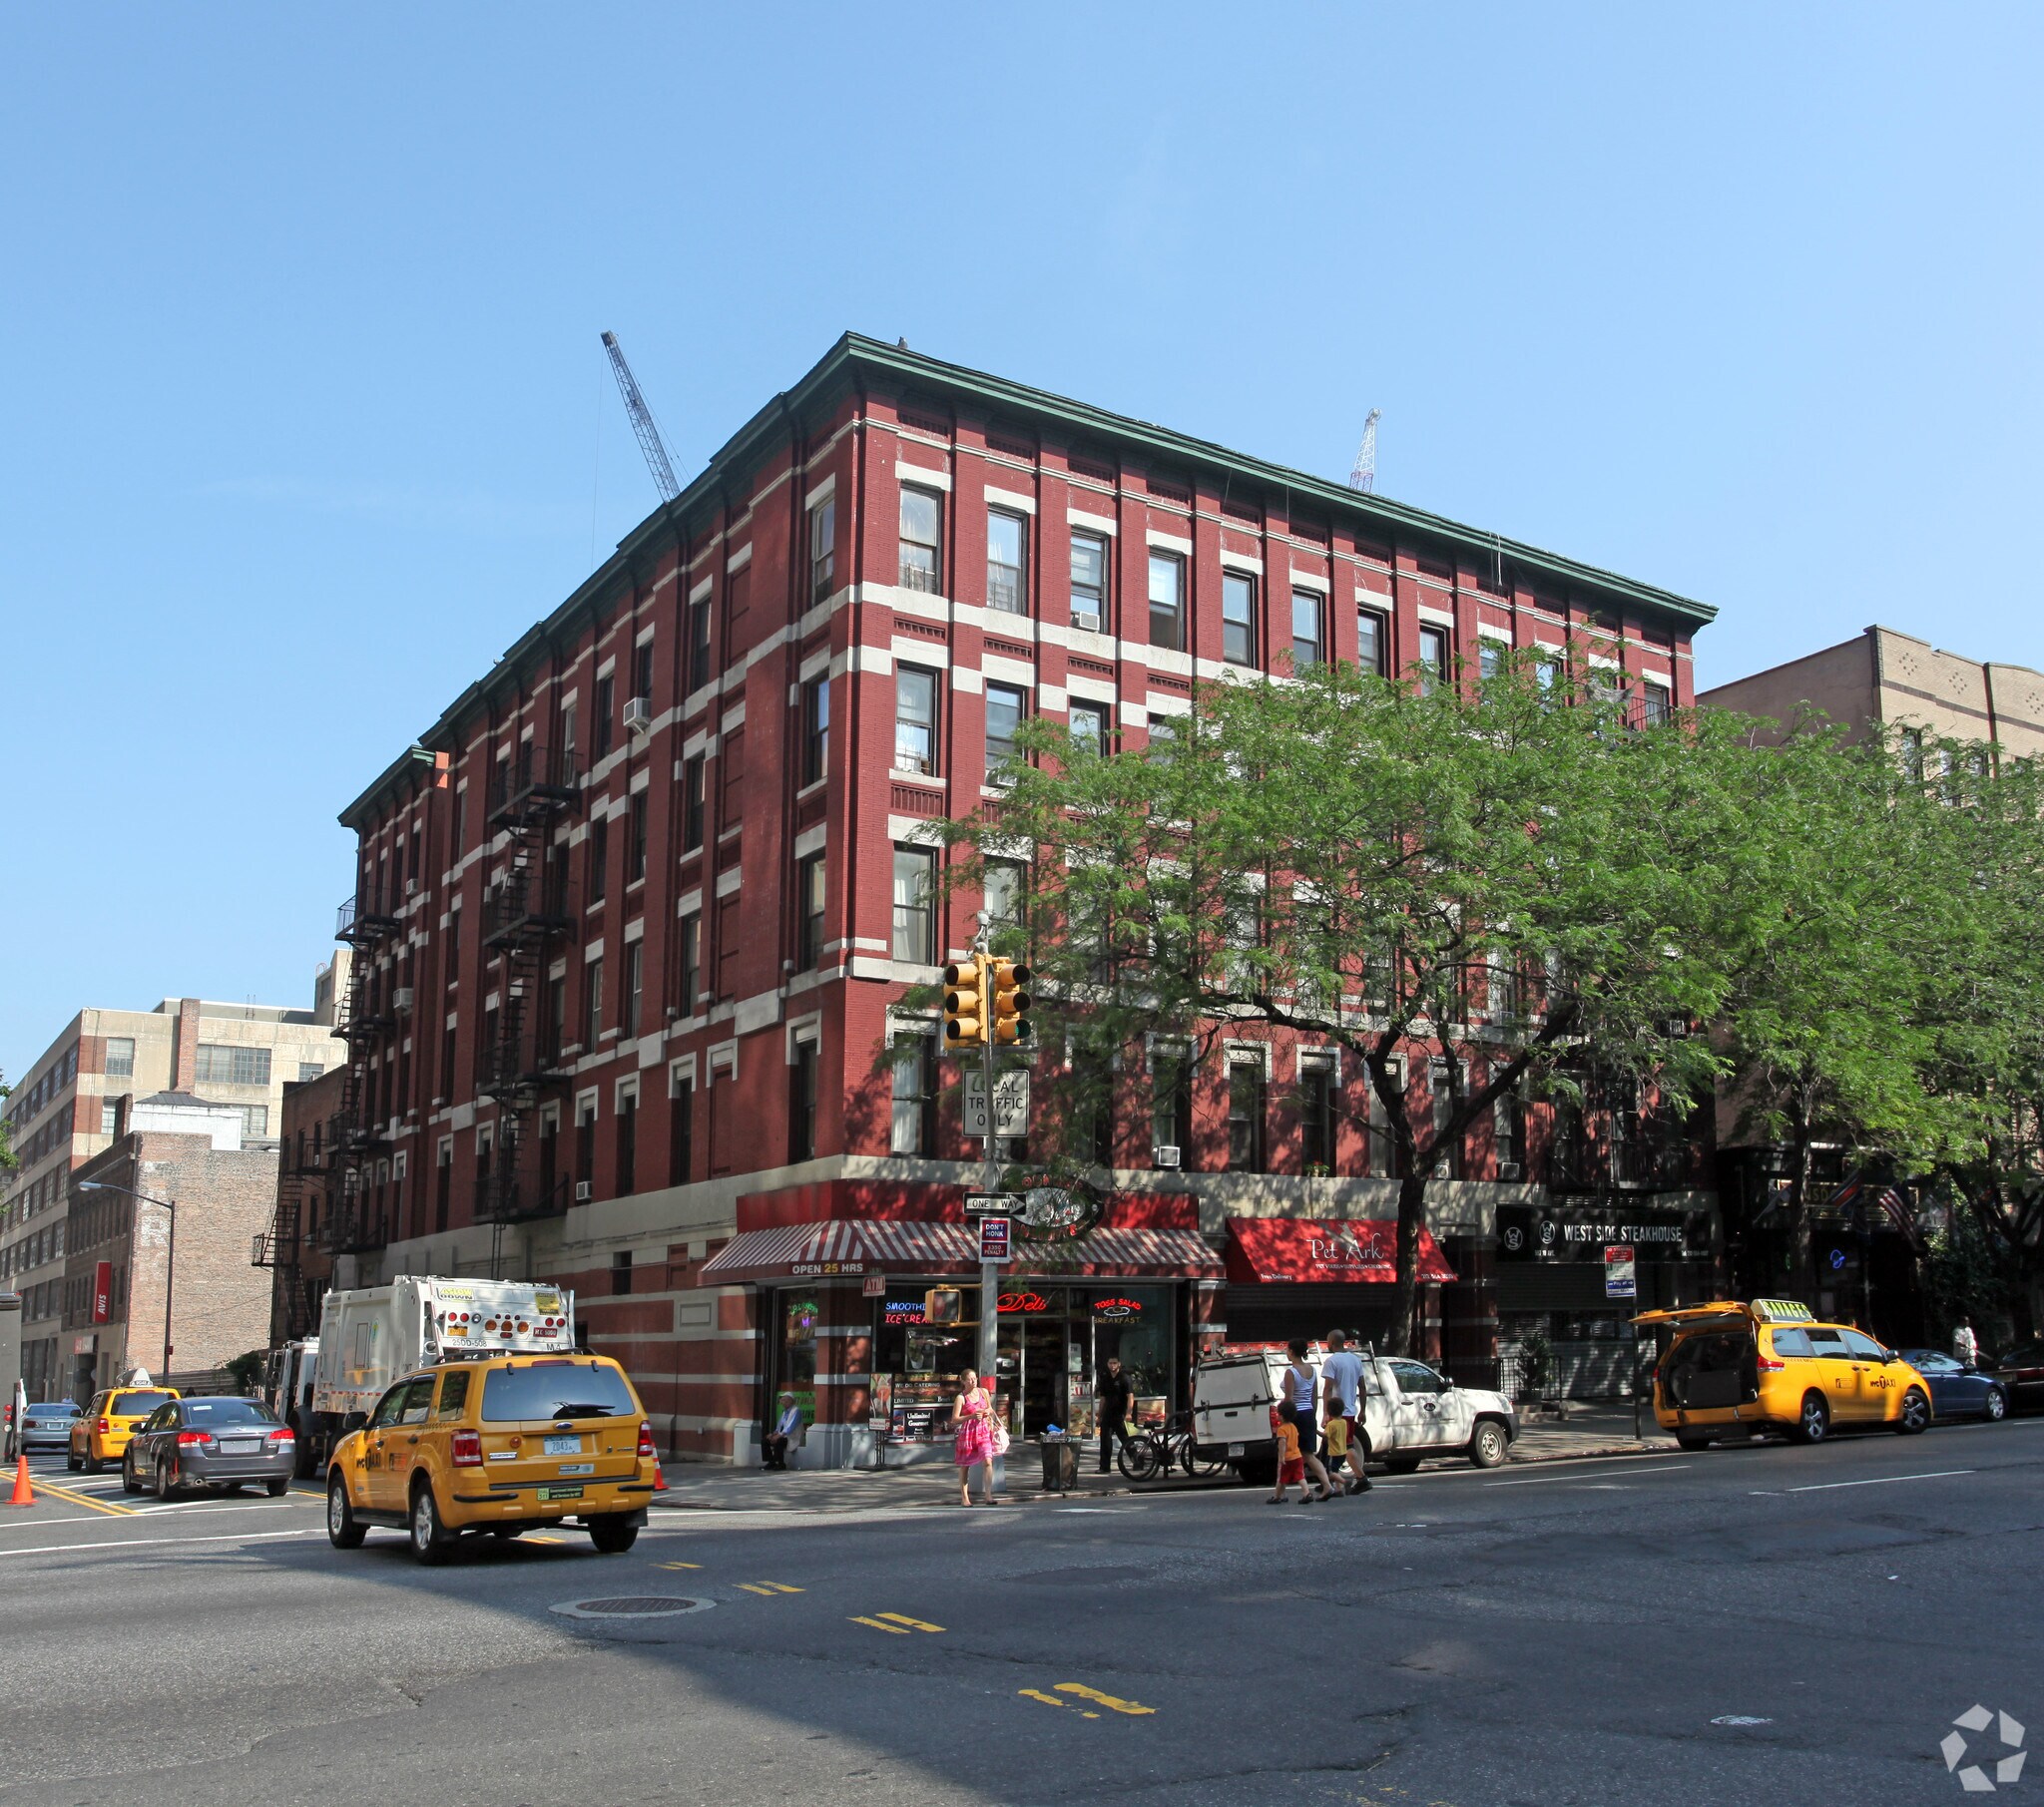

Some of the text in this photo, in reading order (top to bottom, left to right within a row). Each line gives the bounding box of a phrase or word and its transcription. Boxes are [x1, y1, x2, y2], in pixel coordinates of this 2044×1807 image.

[972, 1081, 1019, 1093] LCAL
[968, 1098, 1023, 1110] TRFFIC
[977, 1114, 1013, 1126] OLY
[972, 1198, 1018, 1208] ONE WAY
[1564, 1224, 1682, 1242] WEST SIDE STEAKHOUSE
[1305, 1232, 1384, 1262] Pet Ark
[791, 1264, 821, 1274] OPEN
[824, 1263, 838, 1273] 25
[841, 1263, 863, 1272] HRS
[866, 1278, 883, 1292] ATM
[98, 1294, 107, 1315] AVIS
[885, 1301, 926, 1311] SMOOTHI
[996, 1293, 1048, 1311] Deli
[1095, 1298, 1142, 1310] TOSS SALAD
[1763, 1300, 1811, 1318] SAVAGES
[885, 1313, 932, 1324] ICE CREA
